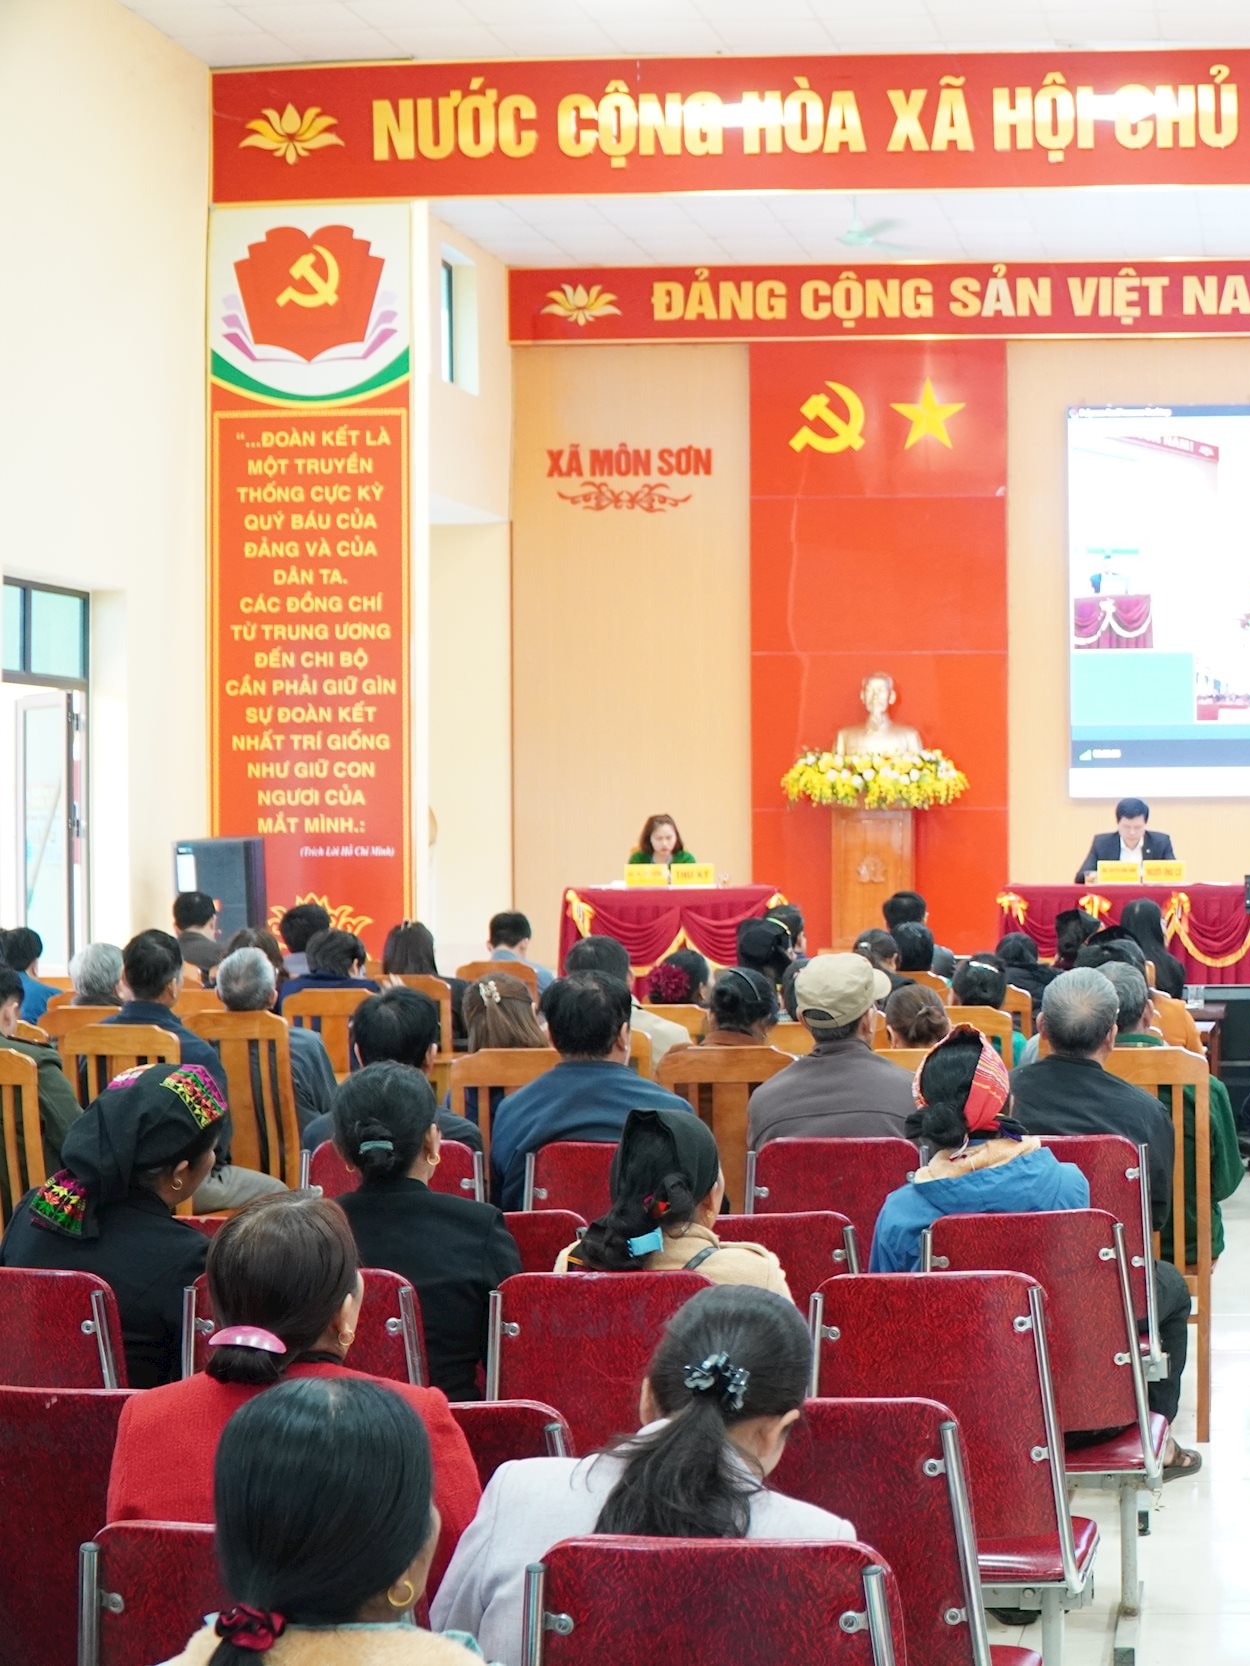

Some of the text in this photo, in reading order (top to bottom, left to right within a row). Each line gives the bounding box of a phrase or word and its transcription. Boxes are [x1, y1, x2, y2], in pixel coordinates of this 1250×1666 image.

[373, 77, 538, 161] NƯỚC
[557, 80, 724, 168] CỘNG
[743, 76, 868, 154] HÒA
[887, 76, 975, 151] XÃ
[992, 71, 1095, 163] HỘI
[1115, 64, 1239, 149] CHỦ
[652, 268, 787, 321] ĐẢNG
[801, 272, 933, 329] CỘNG
[949, 264, 1052, 318] SẢN
[1069, 268, 1170, 325] VIỆT
[322, 425, 360, 446] KẾT
[366, 426, 390, 446] LÀ
[248, 456, 289, 477] MỘT
[547, 442, 713, 477] XÃ MÔN SƠN
[237, 481, 305, 503] THỐNG
[311, 484, 351, 504] CỰC
[291, 510, 331, 530] BÁU
[336, 508, 377, 529] CỦA
[244, 535, 377, 558] ĐẢNG VÀ CỦA
[274, 566, 314, 585] DÂN
[240, 594, 280, 613] CÁC
[349, 592, 382, 612] CHÍ
[231, 622, 391, 641] TỪ TRUNG ƯƠNG
[255, 647, 368, 670] ĐẾN CHI BỘ
[273, 674, 317, 695] PHẢI
[323, 676, 358, 695] GIỮ
[362, 675, 396, 695] GÌN
[246, 701, 376, 725] SỰ ĐOÀN KẾT
[232, 728, 390, 750] NHẤT TRÍ GIỐNG
[248, 759, 375, 778] NHƯ GIỮ CON
[325, 784, 365, 806] CỦA
